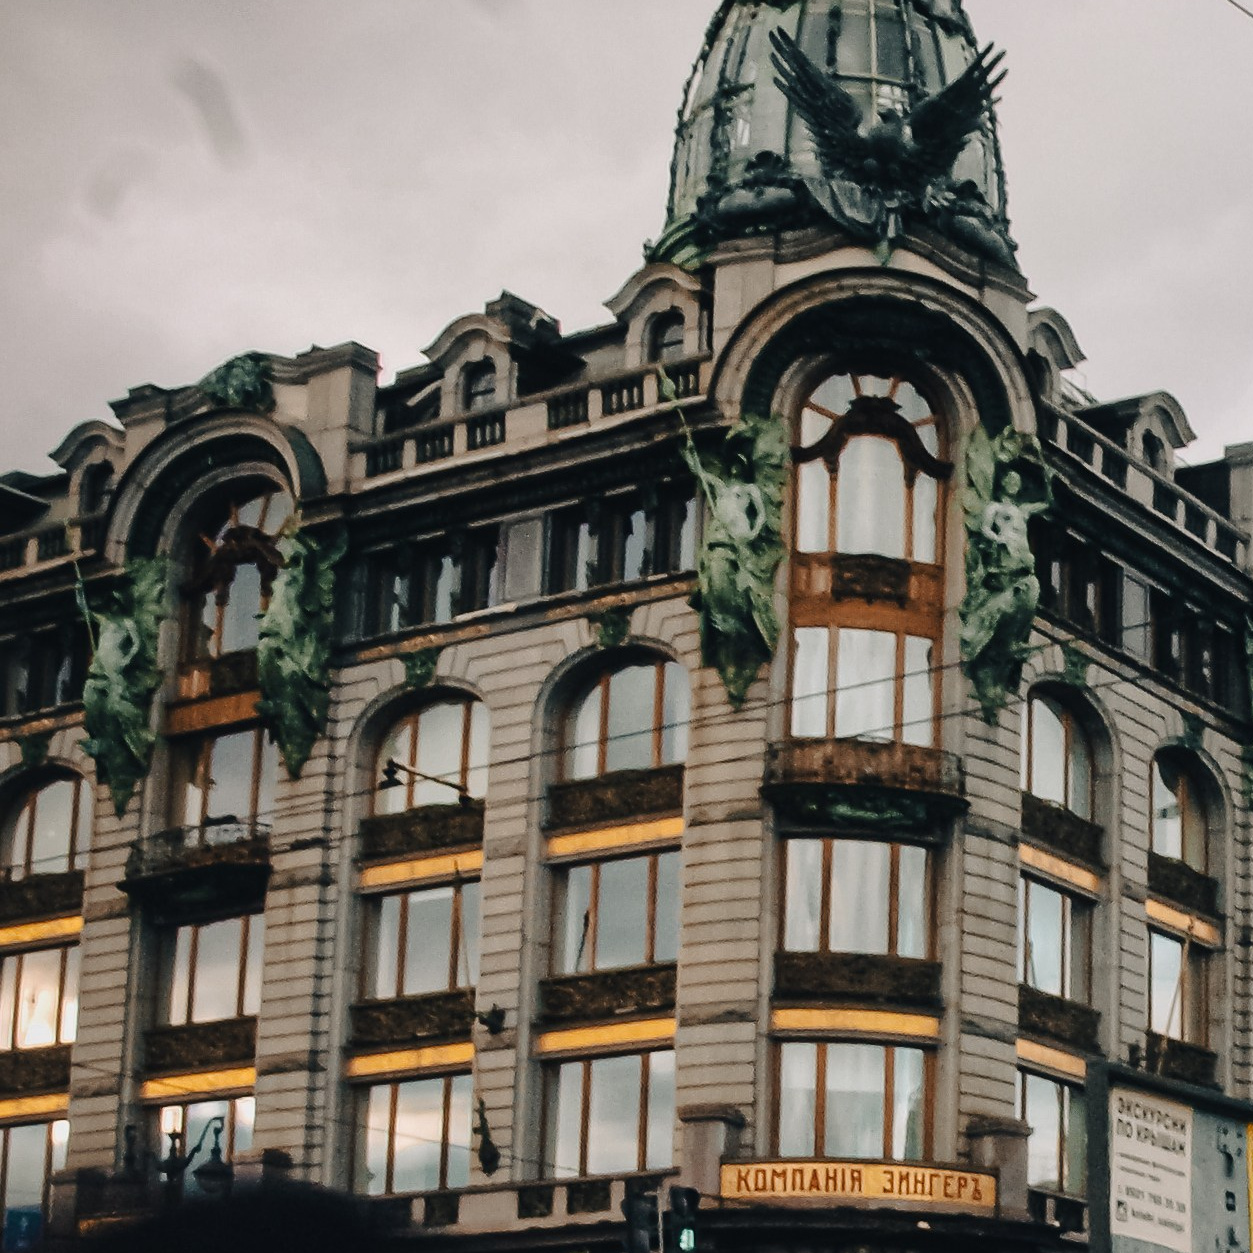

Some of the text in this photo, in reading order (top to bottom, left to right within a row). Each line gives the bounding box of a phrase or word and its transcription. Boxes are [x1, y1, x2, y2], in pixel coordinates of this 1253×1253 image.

[1117, 1118, 1133, 1139] ПО
[736, 1166, 983, 1201] КОМПАНІЯ ЗИНГЕРЪ
